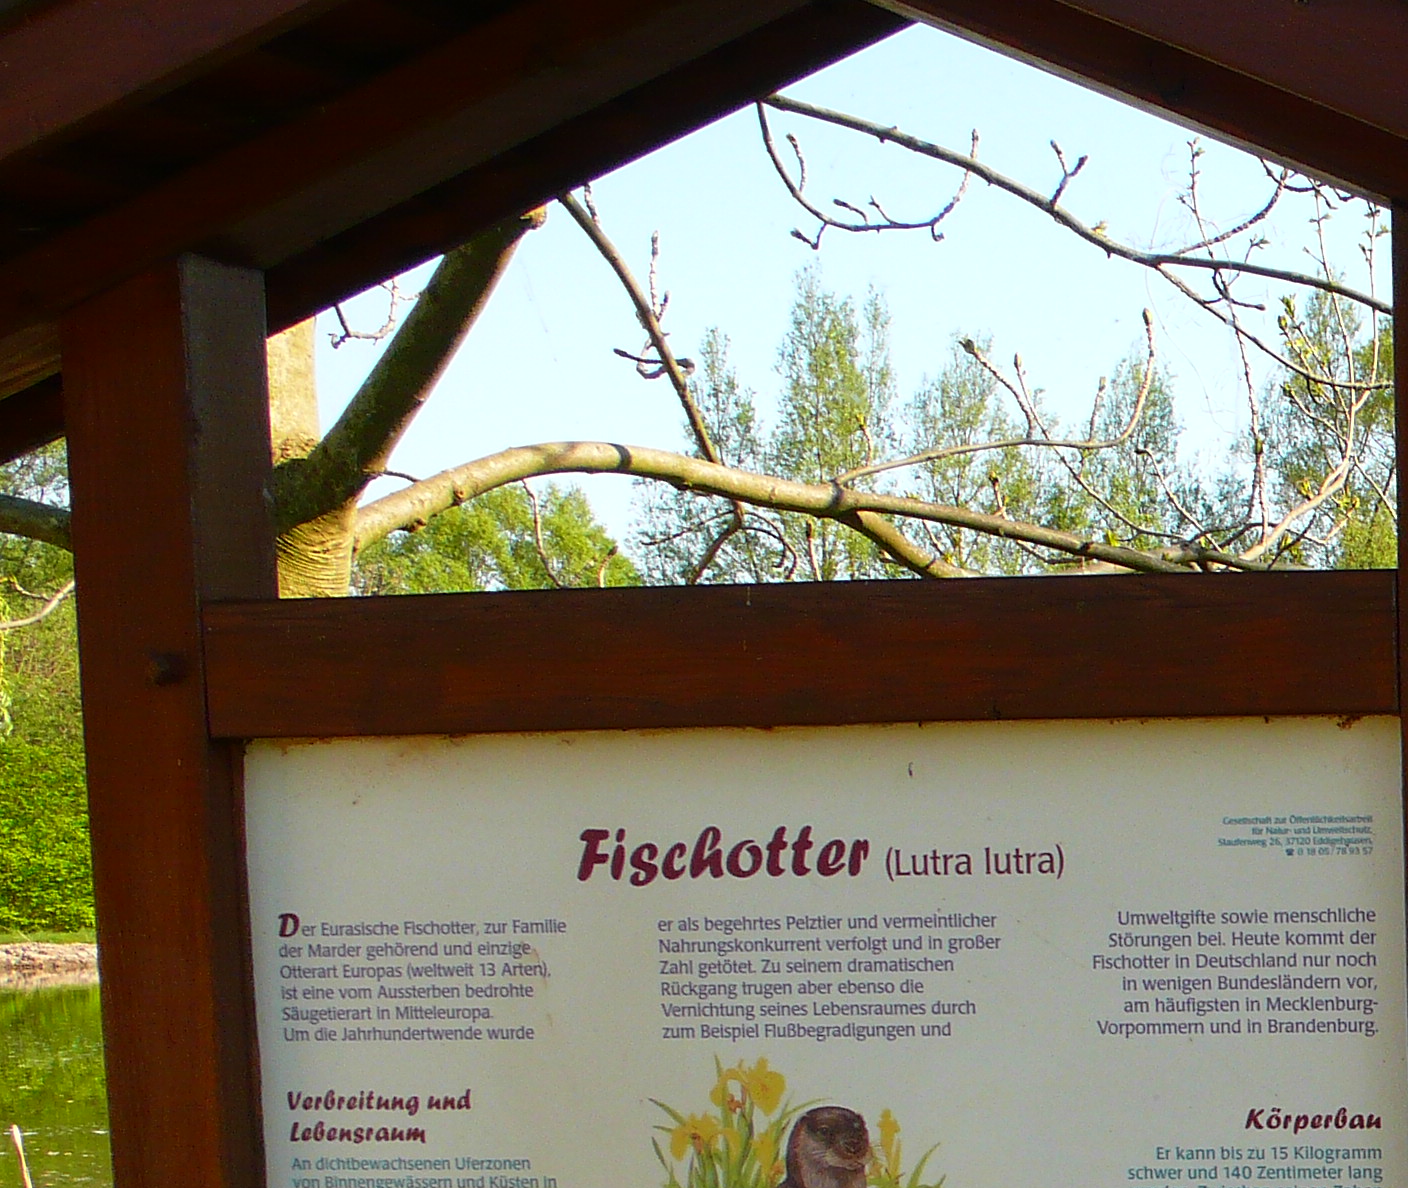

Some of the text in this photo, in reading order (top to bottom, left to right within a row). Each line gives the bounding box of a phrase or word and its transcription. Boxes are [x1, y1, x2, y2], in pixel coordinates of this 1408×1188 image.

[577, 824, 1064, 887] Fischotter (Lutra lutra)
[278, 911, 316, 937] Der
[322, 921, 399, 936] Eurasische
[484, 921, 507, 933] zur
[513, 918, 566, 933] Familie
[658, 913, 997, 935] er als begehrtes Pelztier und vermeintlicher
[1118, 907, 1376, 929] Umweltgifte sowie menschliche
[659, 933, 1001, 956] Nahrungskonkurrent verfolgt und in großer
[1109, 929, 1191, 950] Störungen
[1232, 930, 1280, 945] Heute
[1285, 930, 1344, 945] kommt
[1350, 929, 1376, 945] der
[279, 940, 531, 961] der Marder gehörend und einzige
[1093, 951, 1376, 969] Fischotter in Deutschland nur noch
[659, 953, 954, 978] Zahl getötet. Zu seinem dramatischen
[282, 983, 534, 1000] ist eine vom Aussterben bedrohte
[1123, 973, 1377, 995] in wenigen Bundesländern vor,
[283, 1006, 372, 1024] Säugetierart
[377, 1005, 390, 1019] in
[661, 997, 976, 1020] Vernichtung seines Lebensraumes durch
[284, 1025, 534, 1042] Um die Jahrhundertwende wurde
[662, 1021, 951, 1042] zum Beispiel Flußbegradigungen und
[1097, 1017, 1378, 1038] Vorpommern und in Brandenburg.
[288, 1088, 471, 1116] Verbreitung und
[1245, 1106, 1381, 1134] Körperbau
[290, 1120, 426, 1144] Lebensraum
[292, 1156, 531, 1171] An dichtbewachsenen Uferzonen
[1128, 1165, 1383, 1183] schwer und 140 Zentimeter lang
[293, 1178, 320, 1188] von
[457, 1175, 485, 1188] und
[544, 1175, 557, 1188] in
